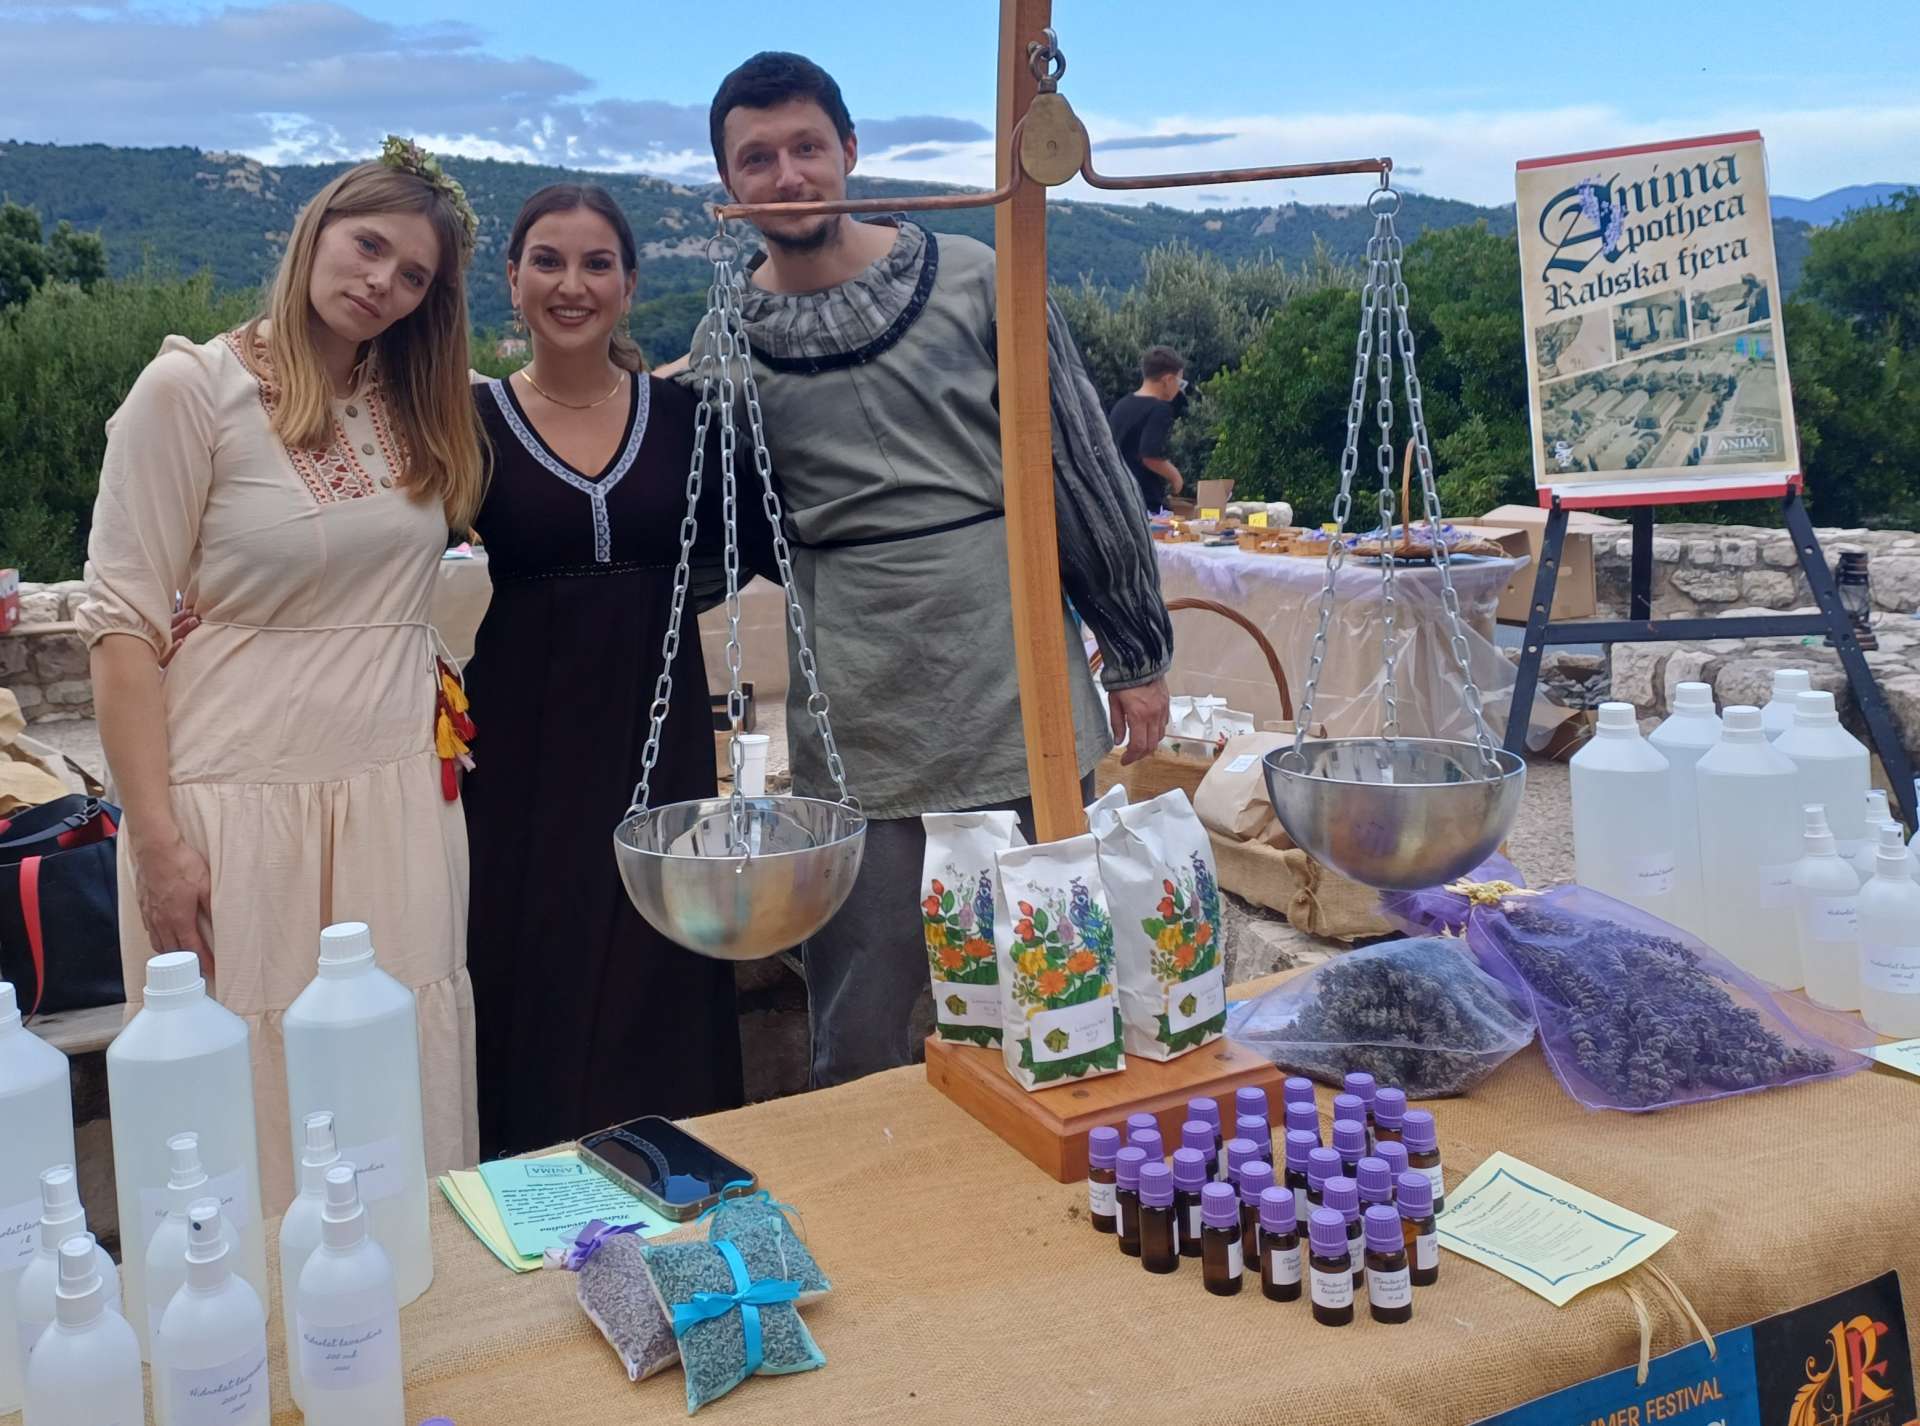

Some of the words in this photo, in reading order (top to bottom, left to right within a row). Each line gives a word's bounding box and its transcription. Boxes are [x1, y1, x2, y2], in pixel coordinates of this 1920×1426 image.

[1543, 259, 1670, 315] Rabska
[1678, 237, 1748, 280] fjera
[1718, 436, 1769, 451] ANIMA
[1646, 1377, 1723, 1423] FESTIVAL
